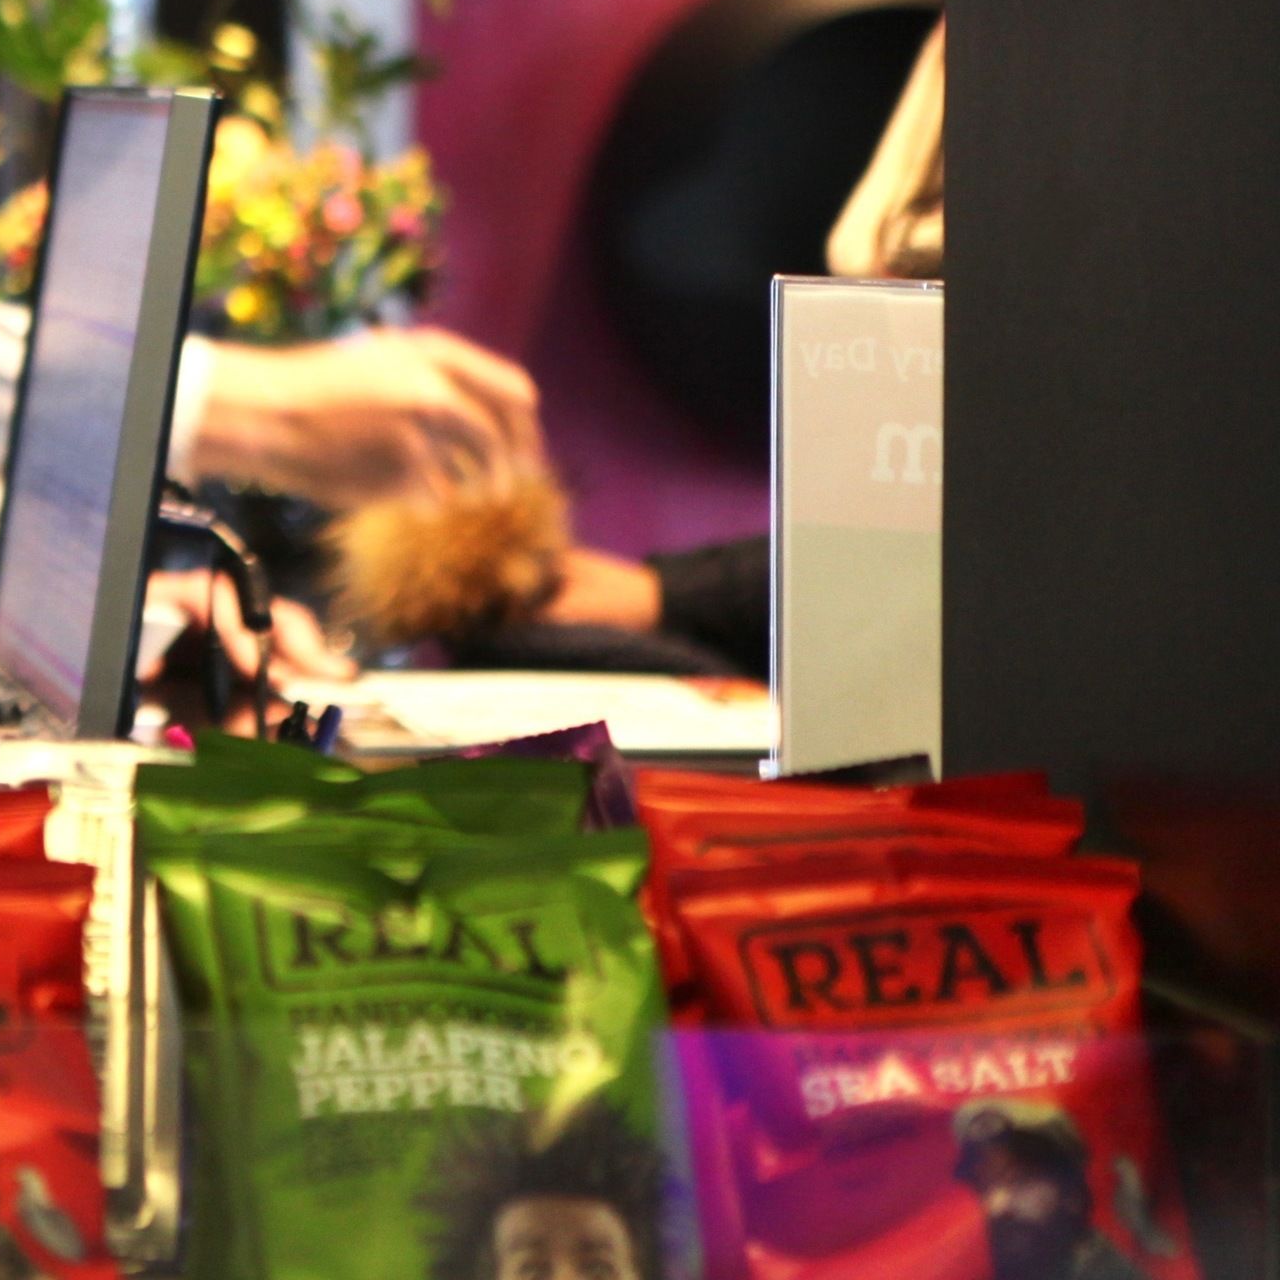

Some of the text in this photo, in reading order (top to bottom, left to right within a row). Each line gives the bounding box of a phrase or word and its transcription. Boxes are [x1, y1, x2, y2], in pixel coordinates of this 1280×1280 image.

[294, 907, 567, 982] REAL
[770, 920, 1087, 1012] REAL
[296, 1070, 524, 1120] PEPPER
[801, 1052, 922, 1118] SEA
[932, 1042, 1076, 1095] SALT
